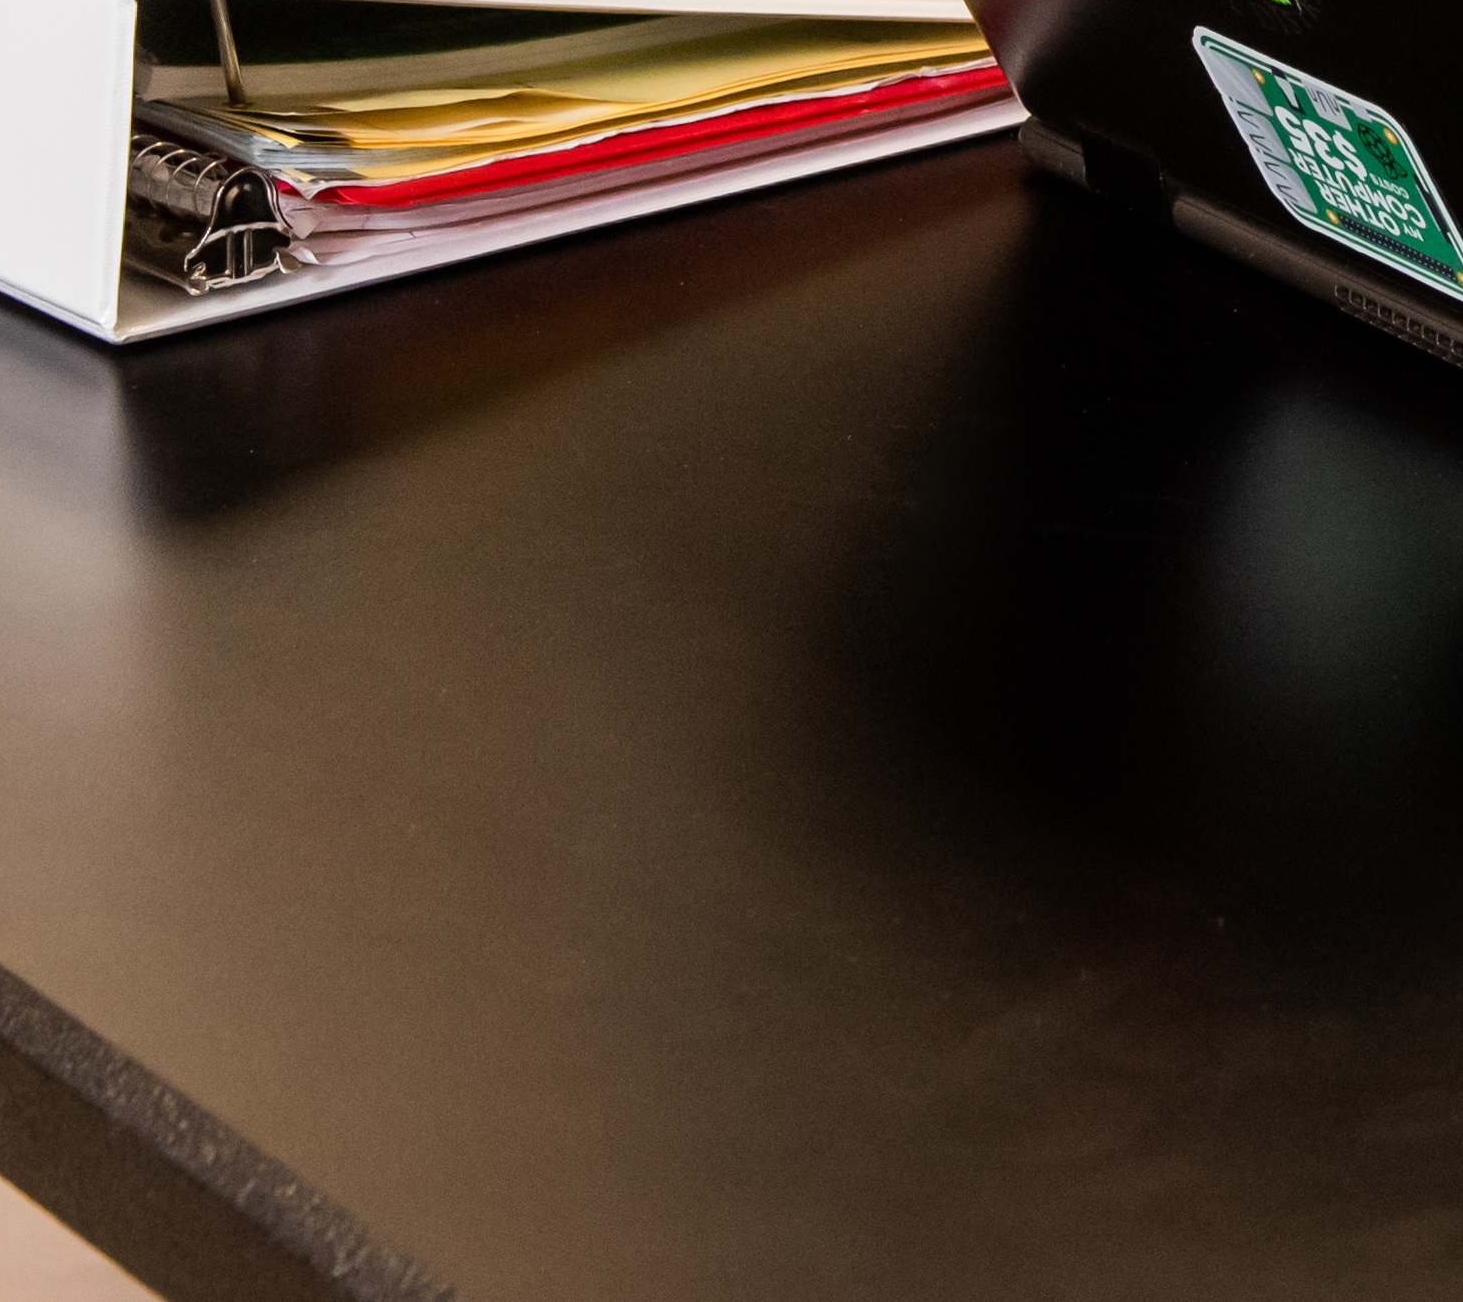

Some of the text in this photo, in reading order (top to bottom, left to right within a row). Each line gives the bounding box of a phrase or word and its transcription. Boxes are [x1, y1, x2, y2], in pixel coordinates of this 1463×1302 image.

[1274, 105, 1409, 200] COSTS $35
[1286, 147, 1427, 229] COMPUTER
[1319, 179, 1425, 242] MY OTHER
